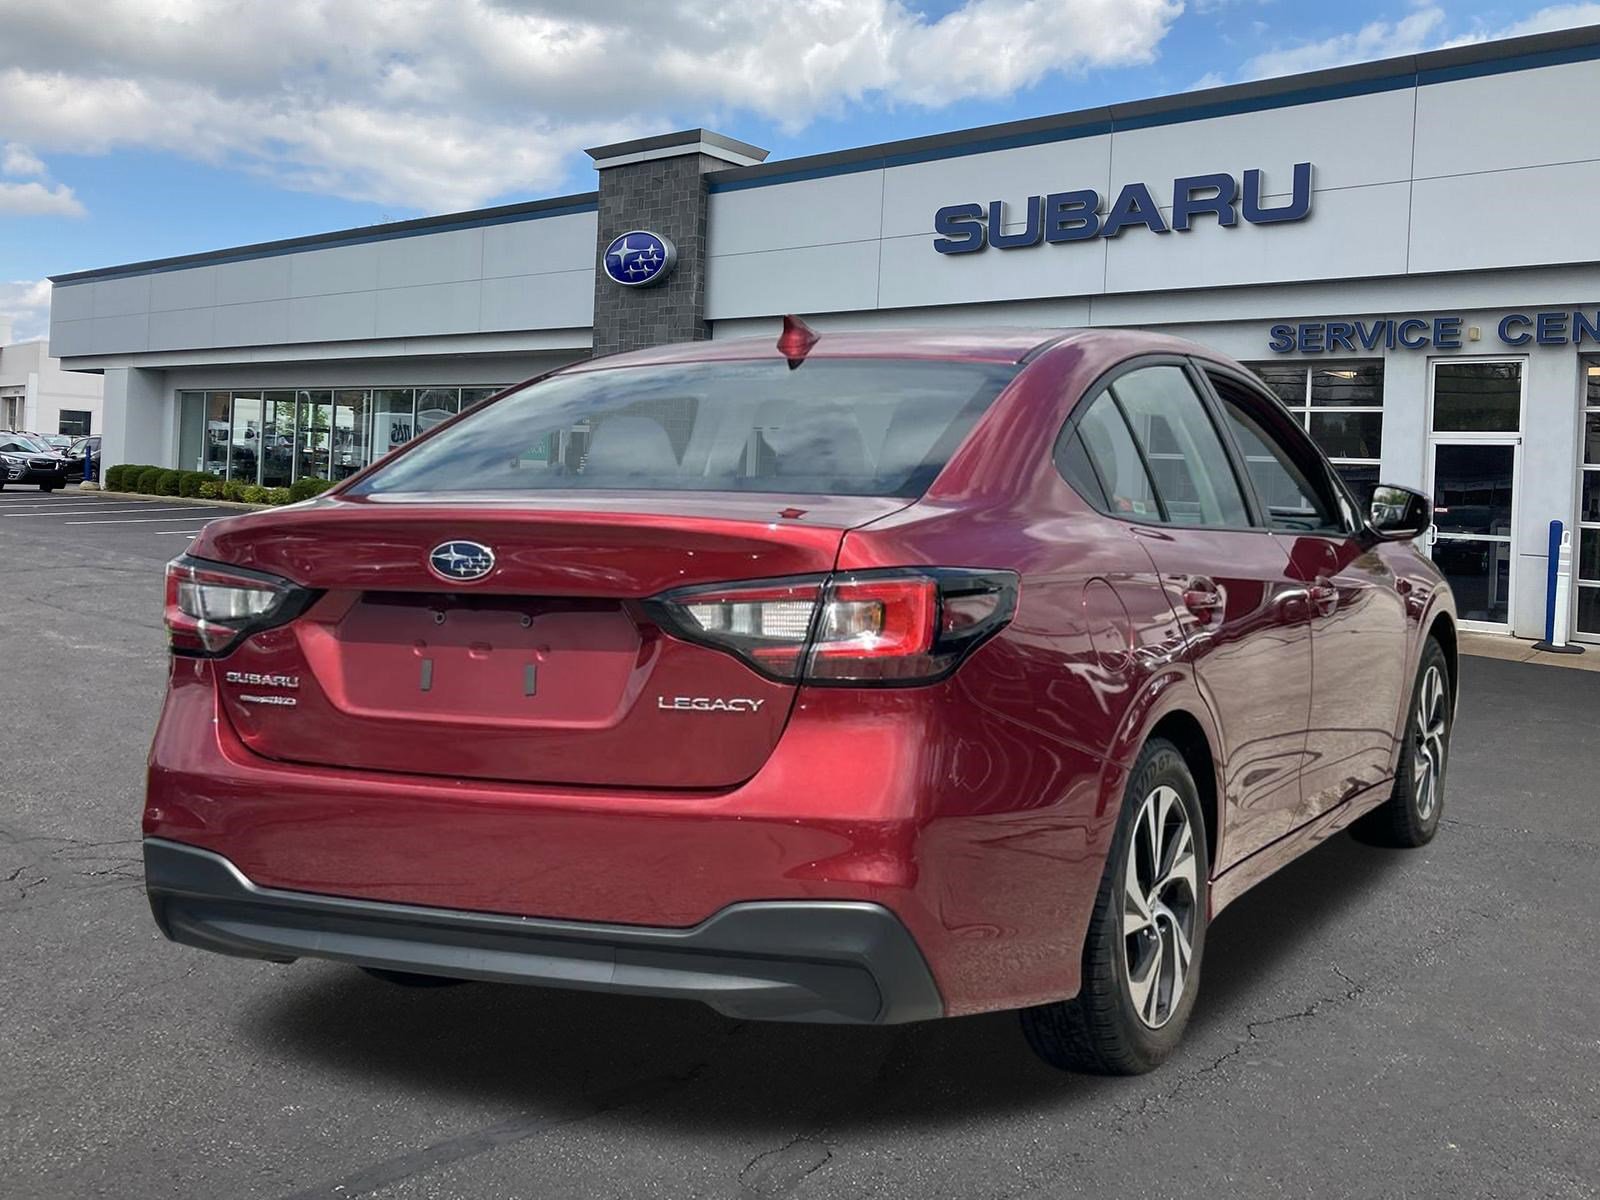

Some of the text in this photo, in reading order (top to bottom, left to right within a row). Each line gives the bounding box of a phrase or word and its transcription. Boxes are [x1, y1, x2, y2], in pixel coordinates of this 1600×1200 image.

[934, 162, 1312, 255] SUBARU
[1269, 310, 1600, 352] SERVICE CEN
[226, 671, 299, 688] SUBARU
[658, 696, 765, 711] LEGACY
